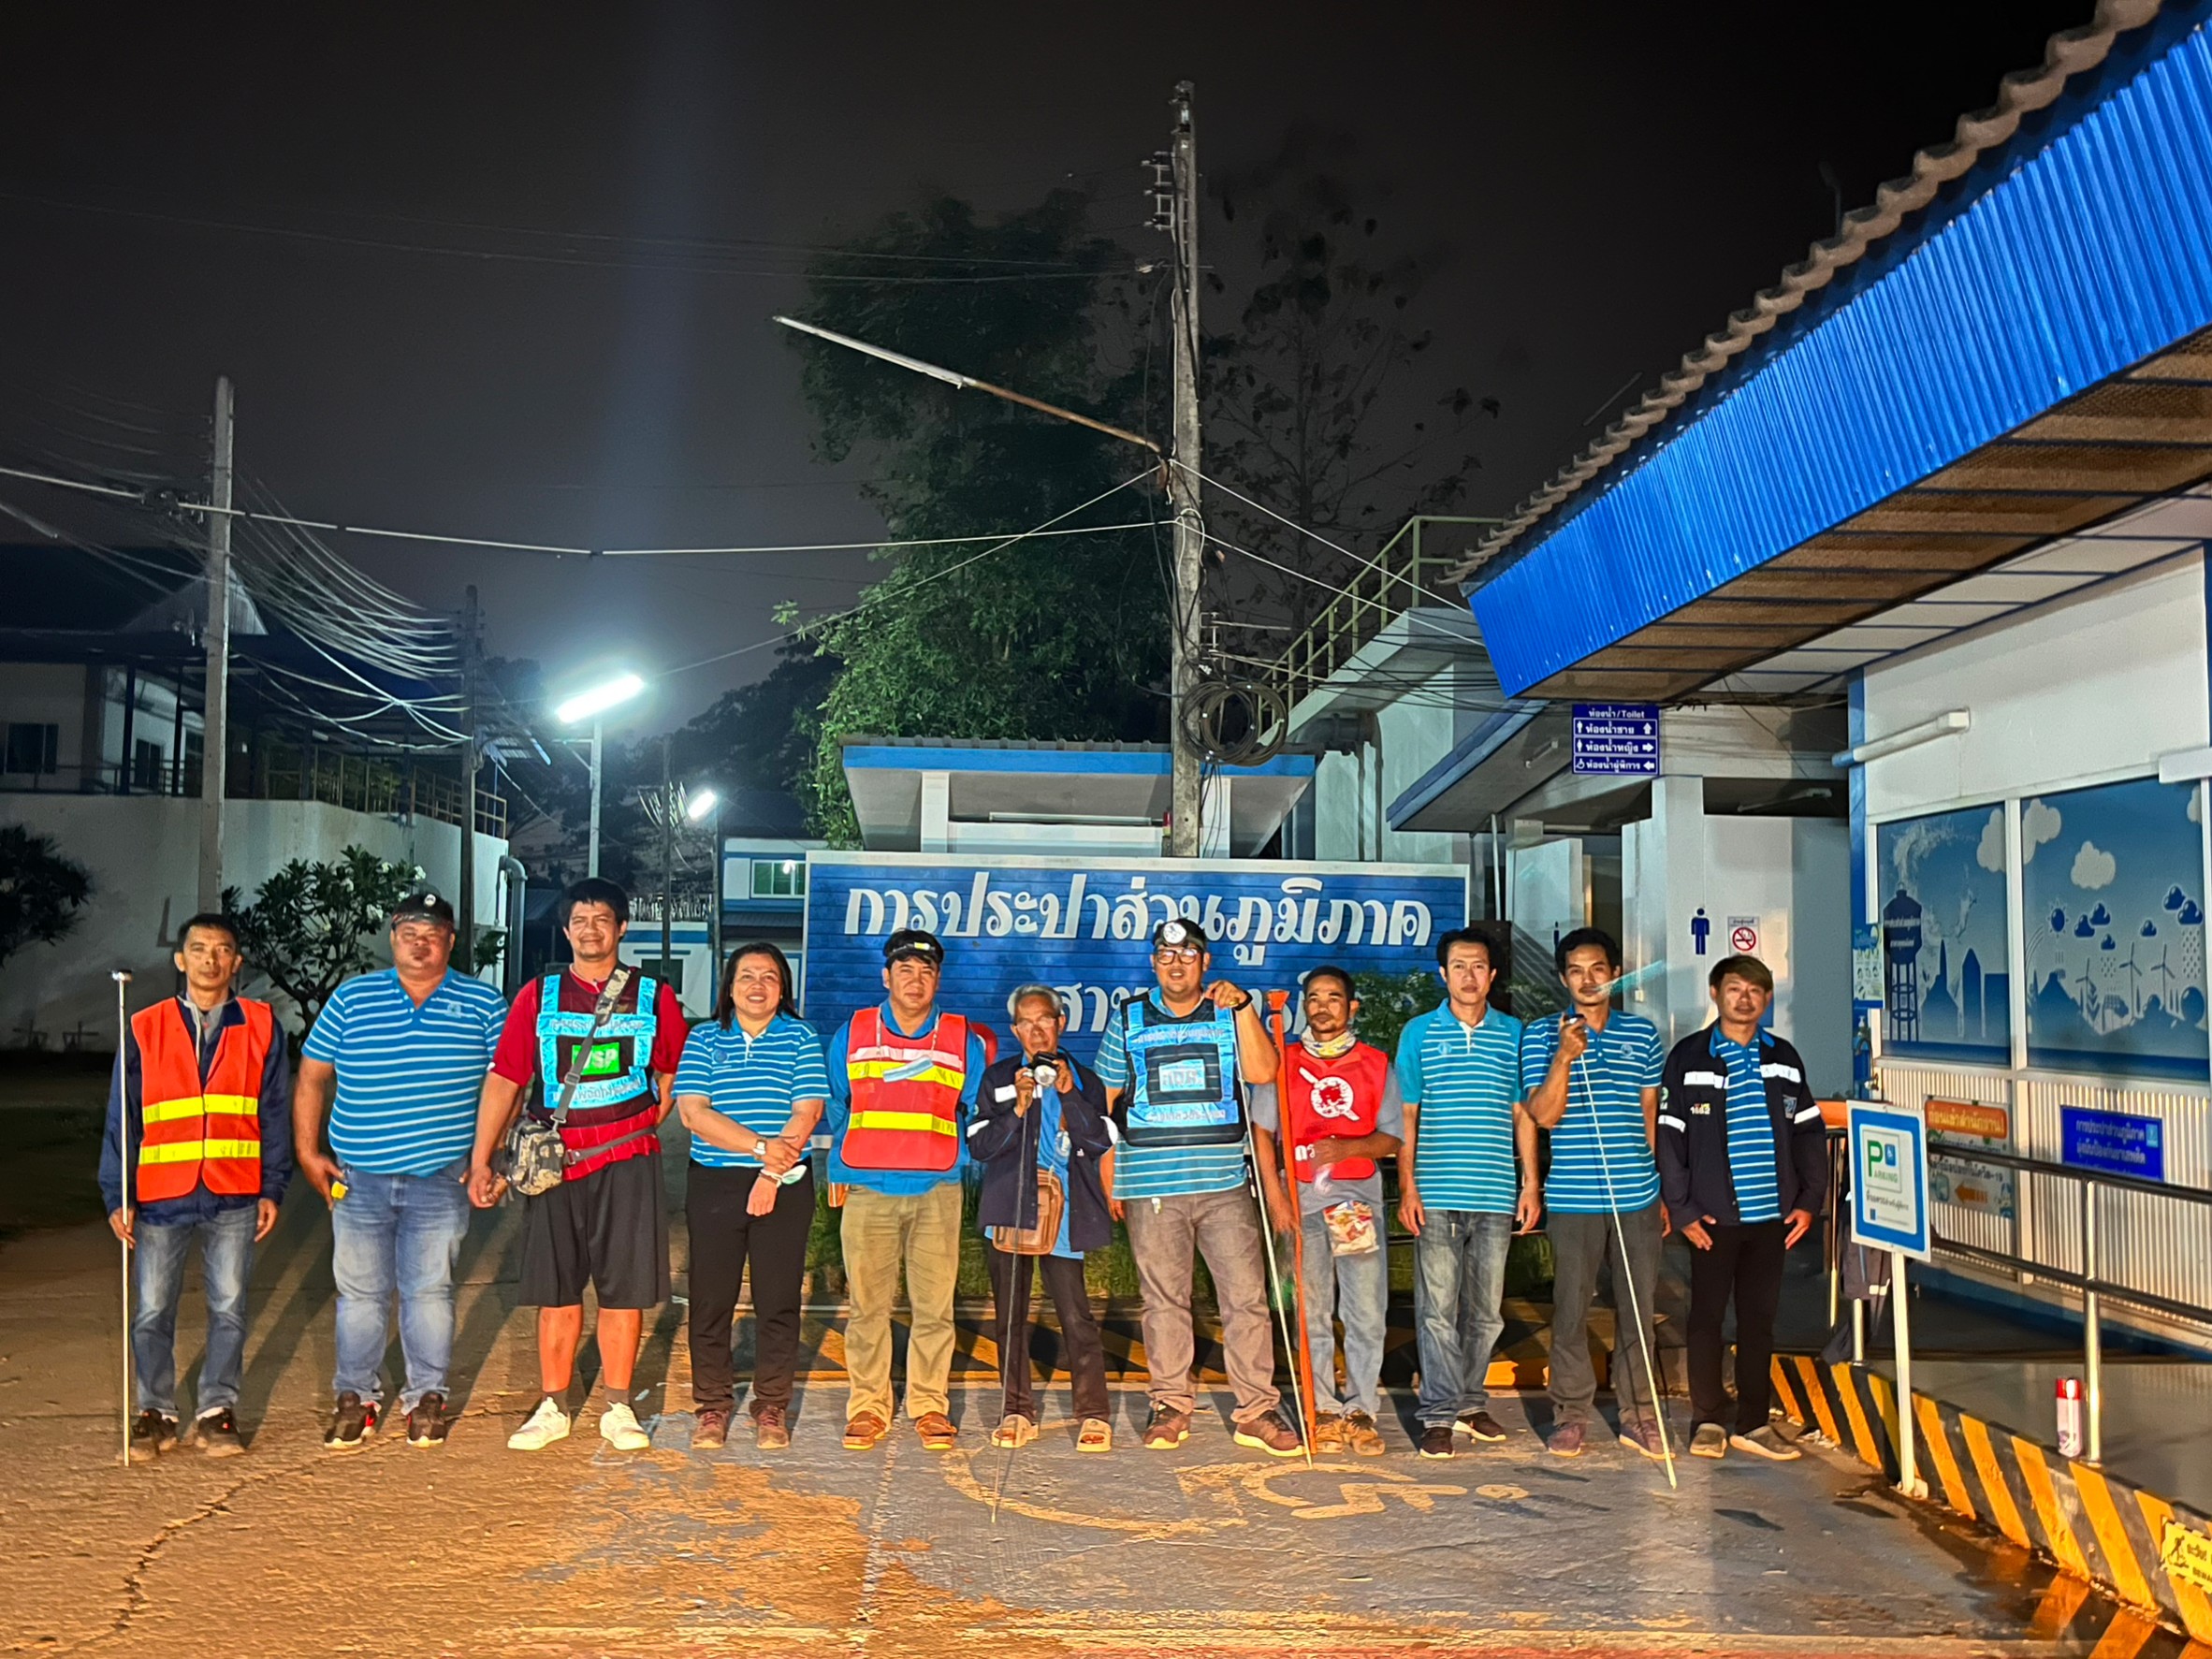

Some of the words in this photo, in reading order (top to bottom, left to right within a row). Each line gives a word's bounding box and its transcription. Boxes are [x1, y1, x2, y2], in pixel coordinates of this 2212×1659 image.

[1585, 720, 1635, 735] ห้องน้ำชาย
[1585, 738, 1639, 755] ห้องน้ำหญิง
[844, 871, 1432, 966] การประปาส่วนภูมิภาค
